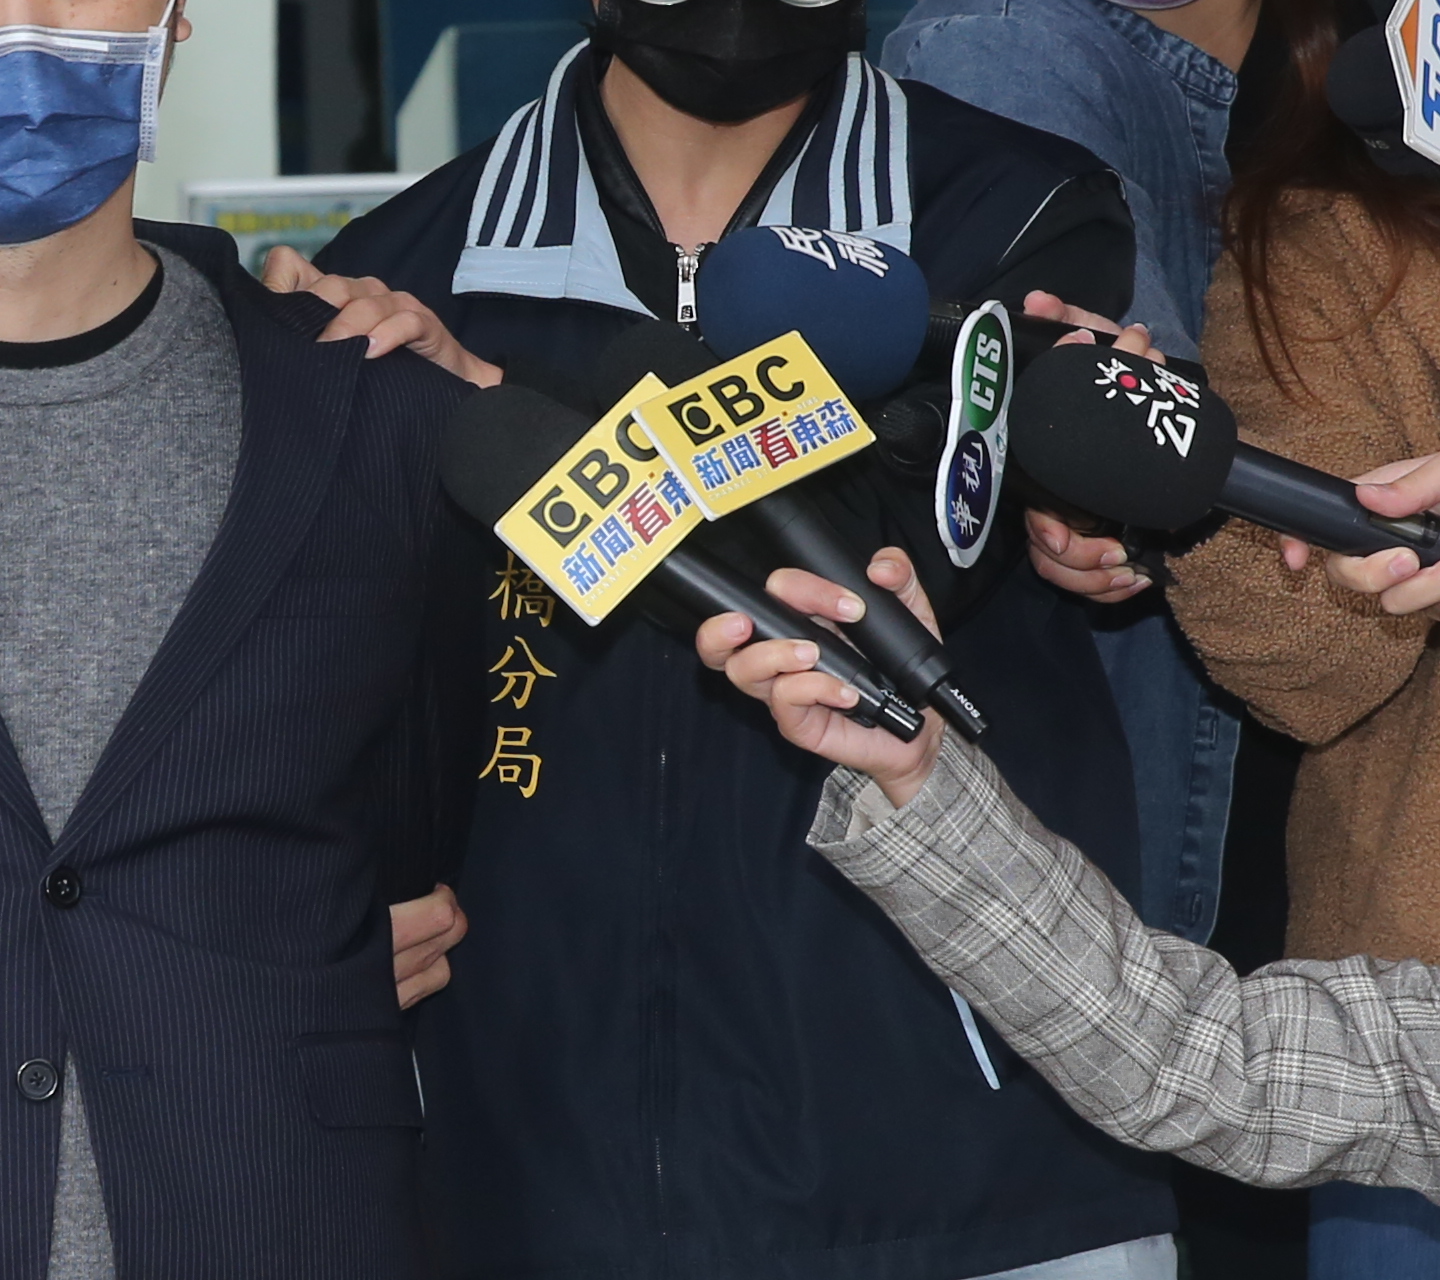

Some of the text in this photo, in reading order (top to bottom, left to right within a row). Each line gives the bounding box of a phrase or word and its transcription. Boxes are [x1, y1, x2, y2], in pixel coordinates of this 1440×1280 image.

[769, 226, 889, 278] 民視
[970, 331, 1002, 413] CTS
[691, 397, 858, 491] 新聞看東森
[561, 469, 692, 597] 新聞看東
[478, 549, 558, 799] 橋分局
[949, 688, 981, 719] SONY
